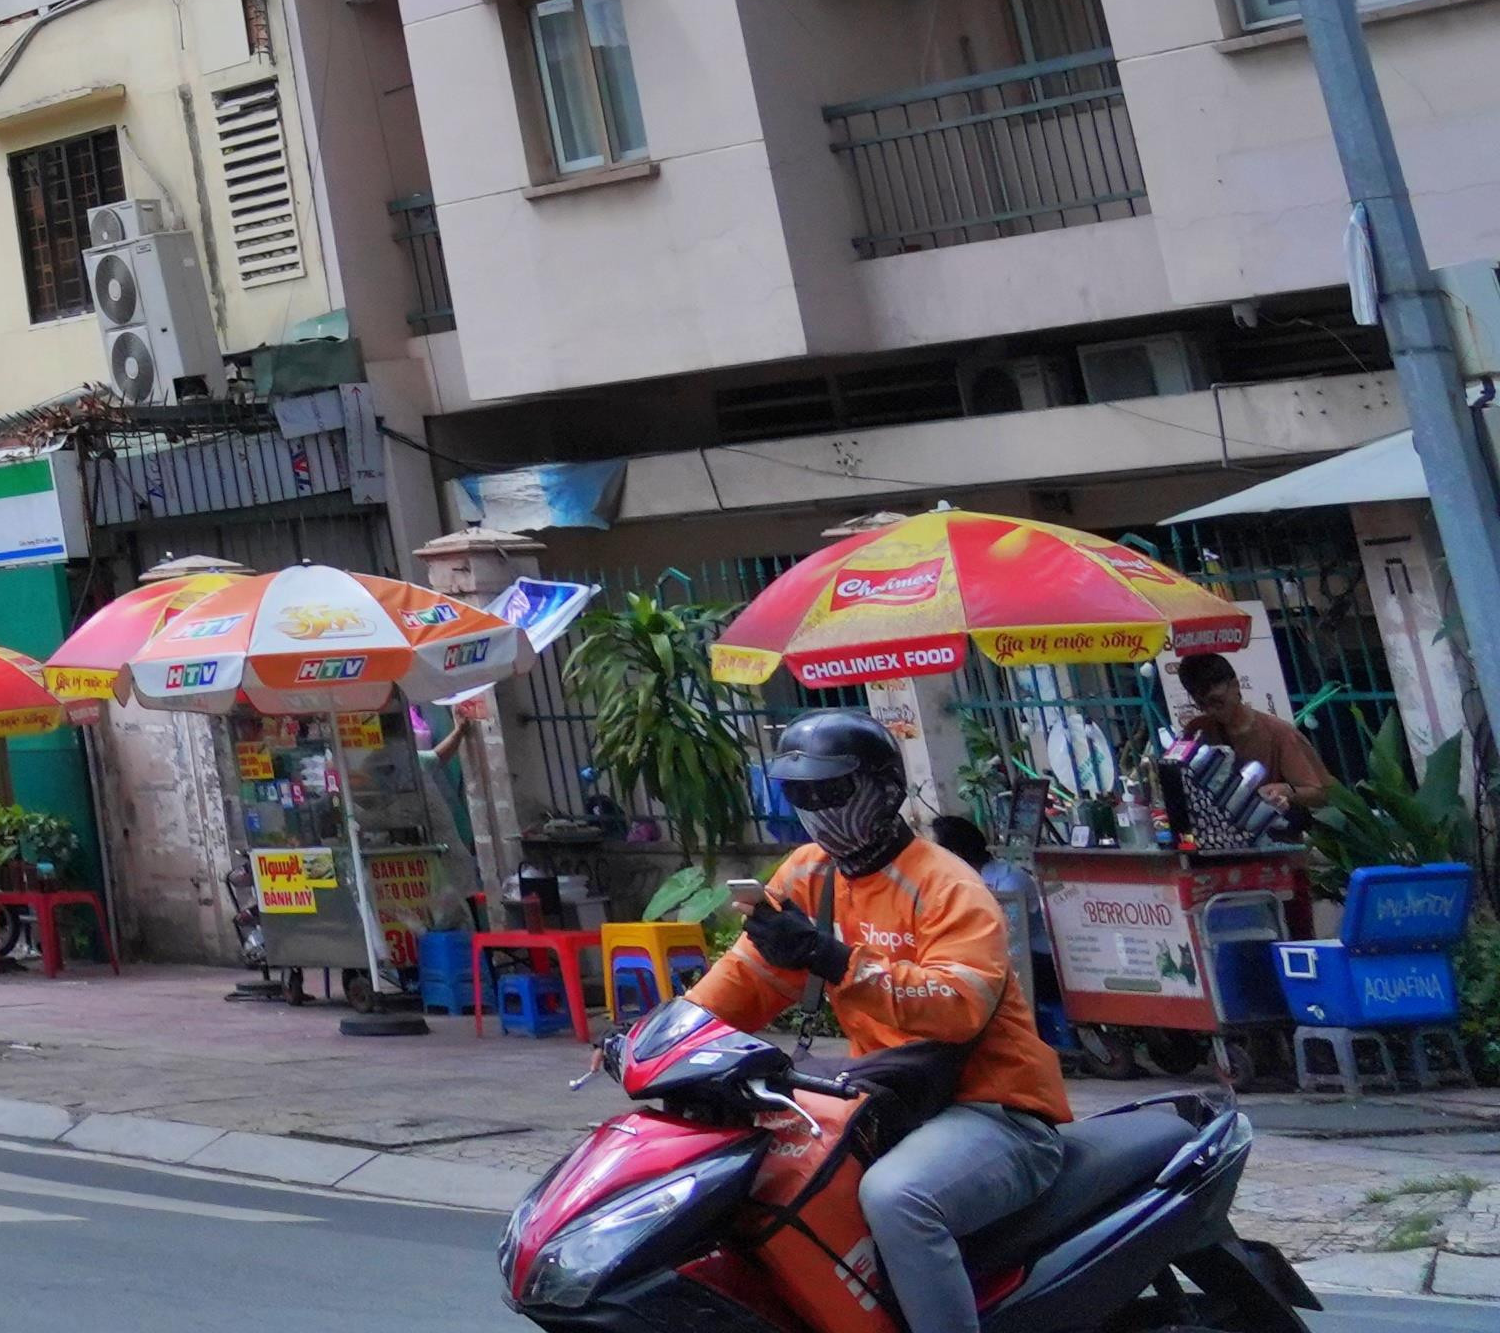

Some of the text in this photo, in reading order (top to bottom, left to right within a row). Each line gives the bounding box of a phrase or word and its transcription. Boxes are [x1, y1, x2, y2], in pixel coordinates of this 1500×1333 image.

[837, 572, 938, 598] Cholimex
[444, 637, 490, 670] HTV
[995, 630, 1150, 663] Gia vị cuộc sống
[165, 661, 218, 688] HTV
[299, 658, 363, 681] HTV
[802, 648, 955, 680] CHOLIMEX FOOD
[1083, 900, 1173, 926] BERROUND
[880, 974, 958, 1003] SpeeFo
[1365, 973, 1444, 1005] AQUAFINA
